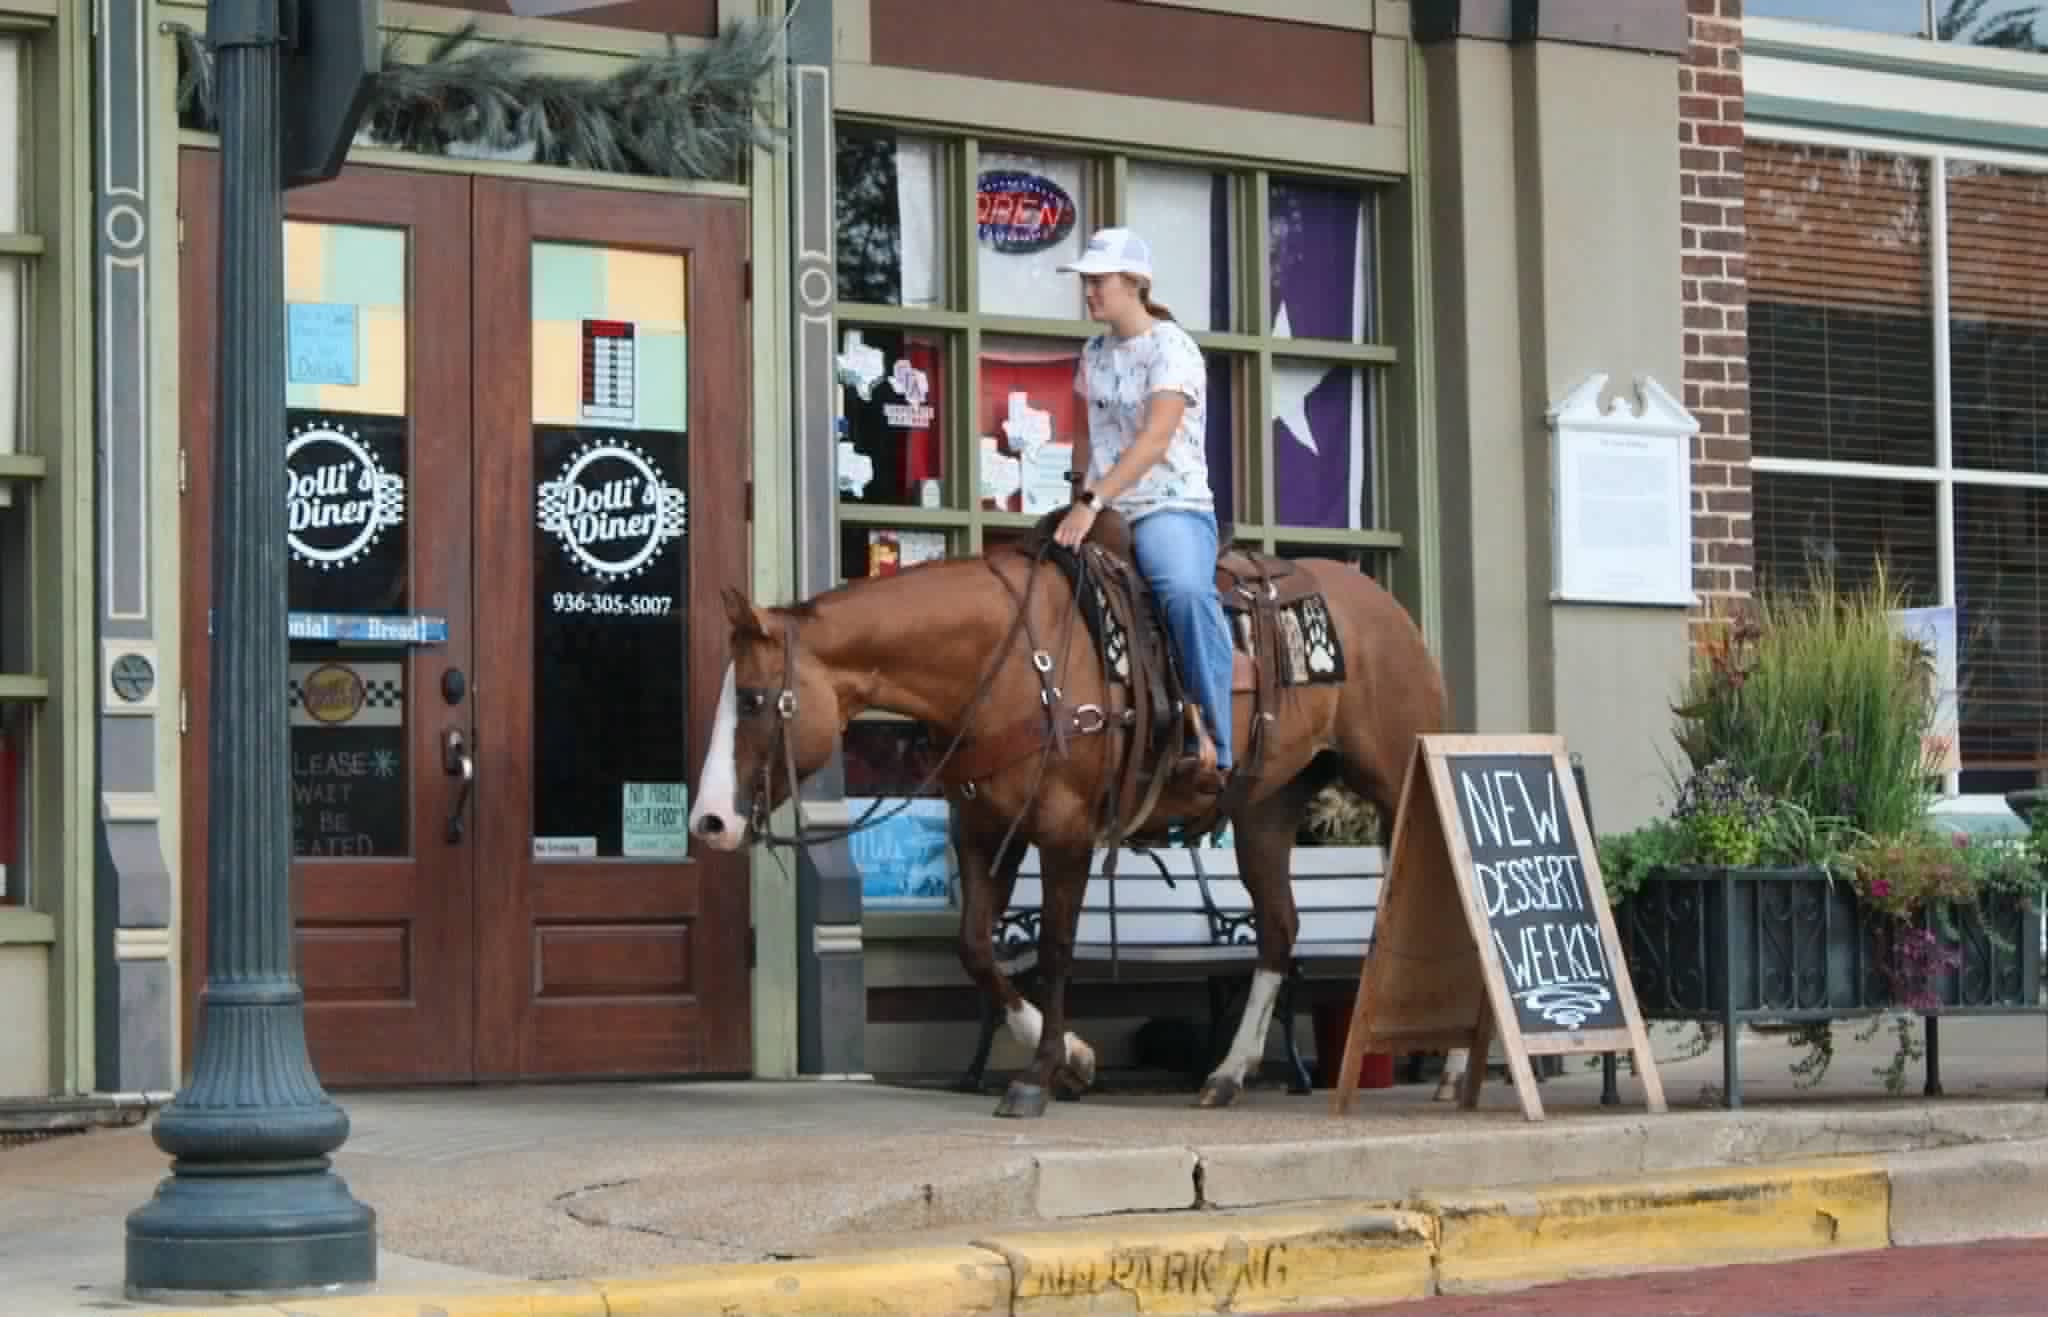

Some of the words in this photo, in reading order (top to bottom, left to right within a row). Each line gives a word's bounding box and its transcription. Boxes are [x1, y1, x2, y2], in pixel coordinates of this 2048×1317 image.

[288, 496, 373, 531] Diner
[562, 477, 657, 515] Dolli's
[573, 511, 657, 544] Diner
[552, 592, 672, 617] 936-305-5007
[294, 752, 368, 776] LEASE
[1461, 770, 1560, 847] NEW
[294, 834, 373, 857] EATED
[1475, 855, 1584, 916] DESSERT
[1493, 923, 1609, 989] WEEKLY
[1110, 1242, 1287, 1293] PARKNG
